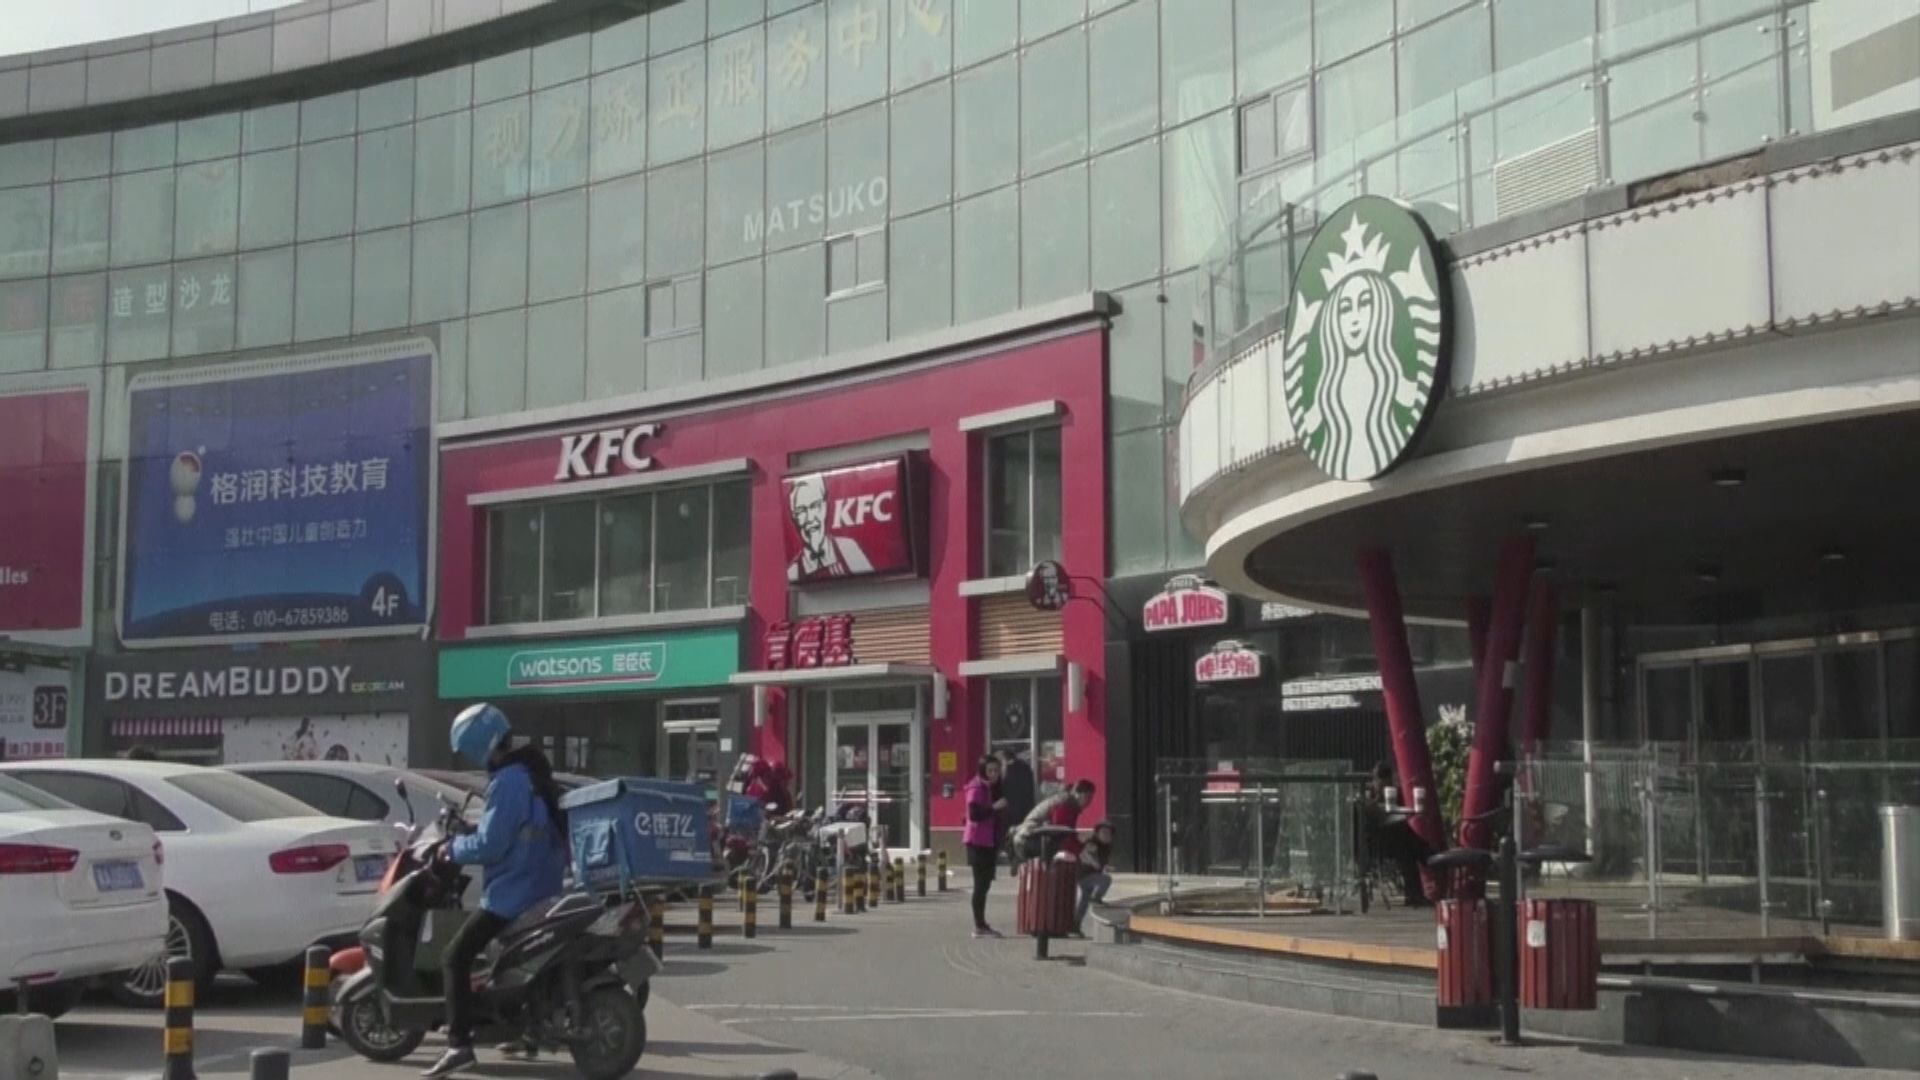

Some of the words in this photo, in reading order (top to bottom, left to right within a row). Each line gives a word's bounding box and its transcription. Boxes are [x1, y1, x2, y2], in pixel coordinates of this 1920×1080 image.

[743, 175, 888, 242] MATSUKO
[111, 273, 231, 317] 造型沙龙
[553, 423, 656, 480] KFC
[209, 457, 389, 505] 格润科技教育
[831, 490, 895, 529] KFC
[252, 606, 349, 628] 010-67859386
[370, 586, 400, 617] 4F
[104, 664, 353, 701] DREAMBUDDY
[519, 655, 603, 677] watsons
[34, 691, 67, 724] 3F
